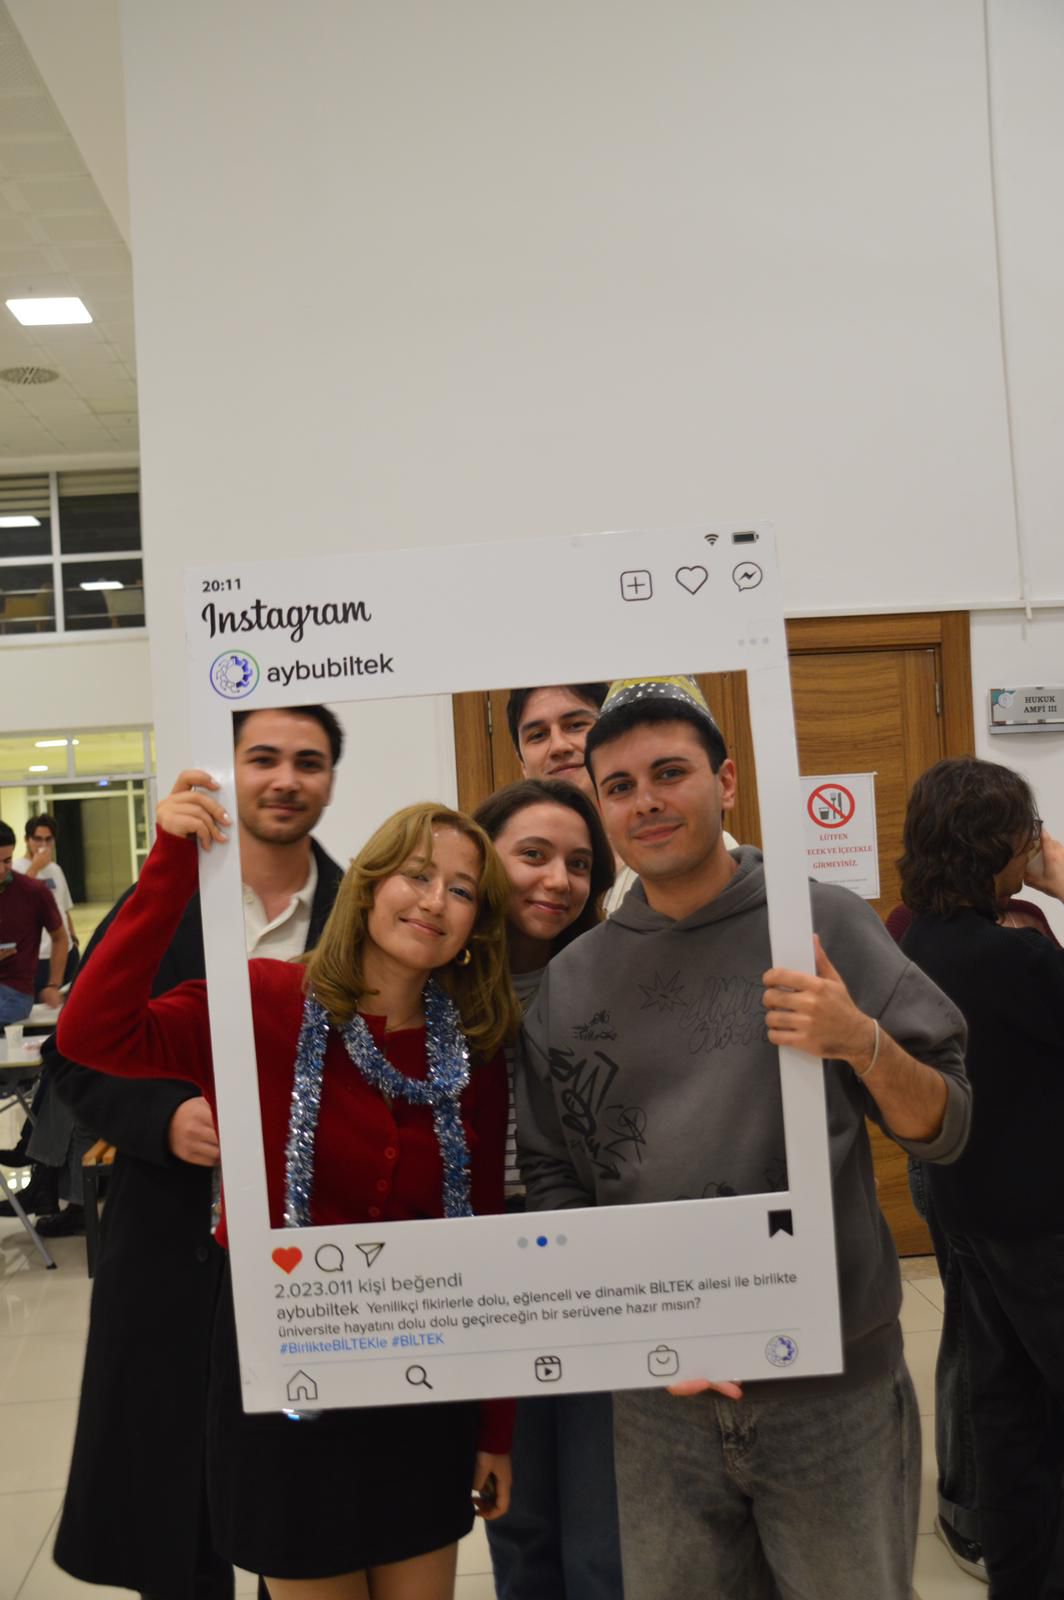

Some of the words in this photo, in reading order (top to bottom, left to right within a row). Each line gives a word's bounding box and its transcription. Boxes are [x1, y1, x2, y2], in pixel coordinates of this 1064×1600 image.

[202, 578, 241, 592] 20:11
[201, 599, 372, 643] Instagram
[267, 653, 394, 687] aybubiltek
[1024, 696, 1055, 704] HUKUK
[1048, 705, 1057, 713] III
[820, 833, 848, 841] LÜTFEN
[807, 848, 826, 856] ECEK
[275, 1280, 353, 1299] 2.023.011
[359, 1277, 386, 1295] kişi
[392, 1273, 463, 1293] beğendi
[277, 1301, 359, 1322] aybubiltek
[366, 1300, 418, 1314] Yenilikçi
[422, 1297, 473, 1310] fikirlerle
[477, 1294, 510, 1307] dolu,
[513, 1288, 572, 1306] eğlenceli
[575, 1289, 591, 1299] ve
[595, 1283, 646, 1298] dinamik
[650, 1279, 694, 1294] BİLTEK
[698, 1277, 731, 1290] ailesi
[735, 1275, 750, 1288] ile
[753, 1273, 797, 1286] birlikte
[279, 1323, 340, 1338] üniversite
[344, 1320, 394, 1335] hayatını
[398, 1318, 426, 1330] dolu
[430, 1315, 458, 1328] dolu
[462, 1309, 538, 1328] geçireceğin
[542, 1308, 558, 1320] bir
[562, 1304, 622, 1319] serüvene
[626, 1302, 657, 1314] hazır
[662, 1297, 701, 1312] mısın?
[280, 1336, 388, 1354] #BirlikteBİLTEKle
[392, 1332, 445, 1347] #BİLTEK
